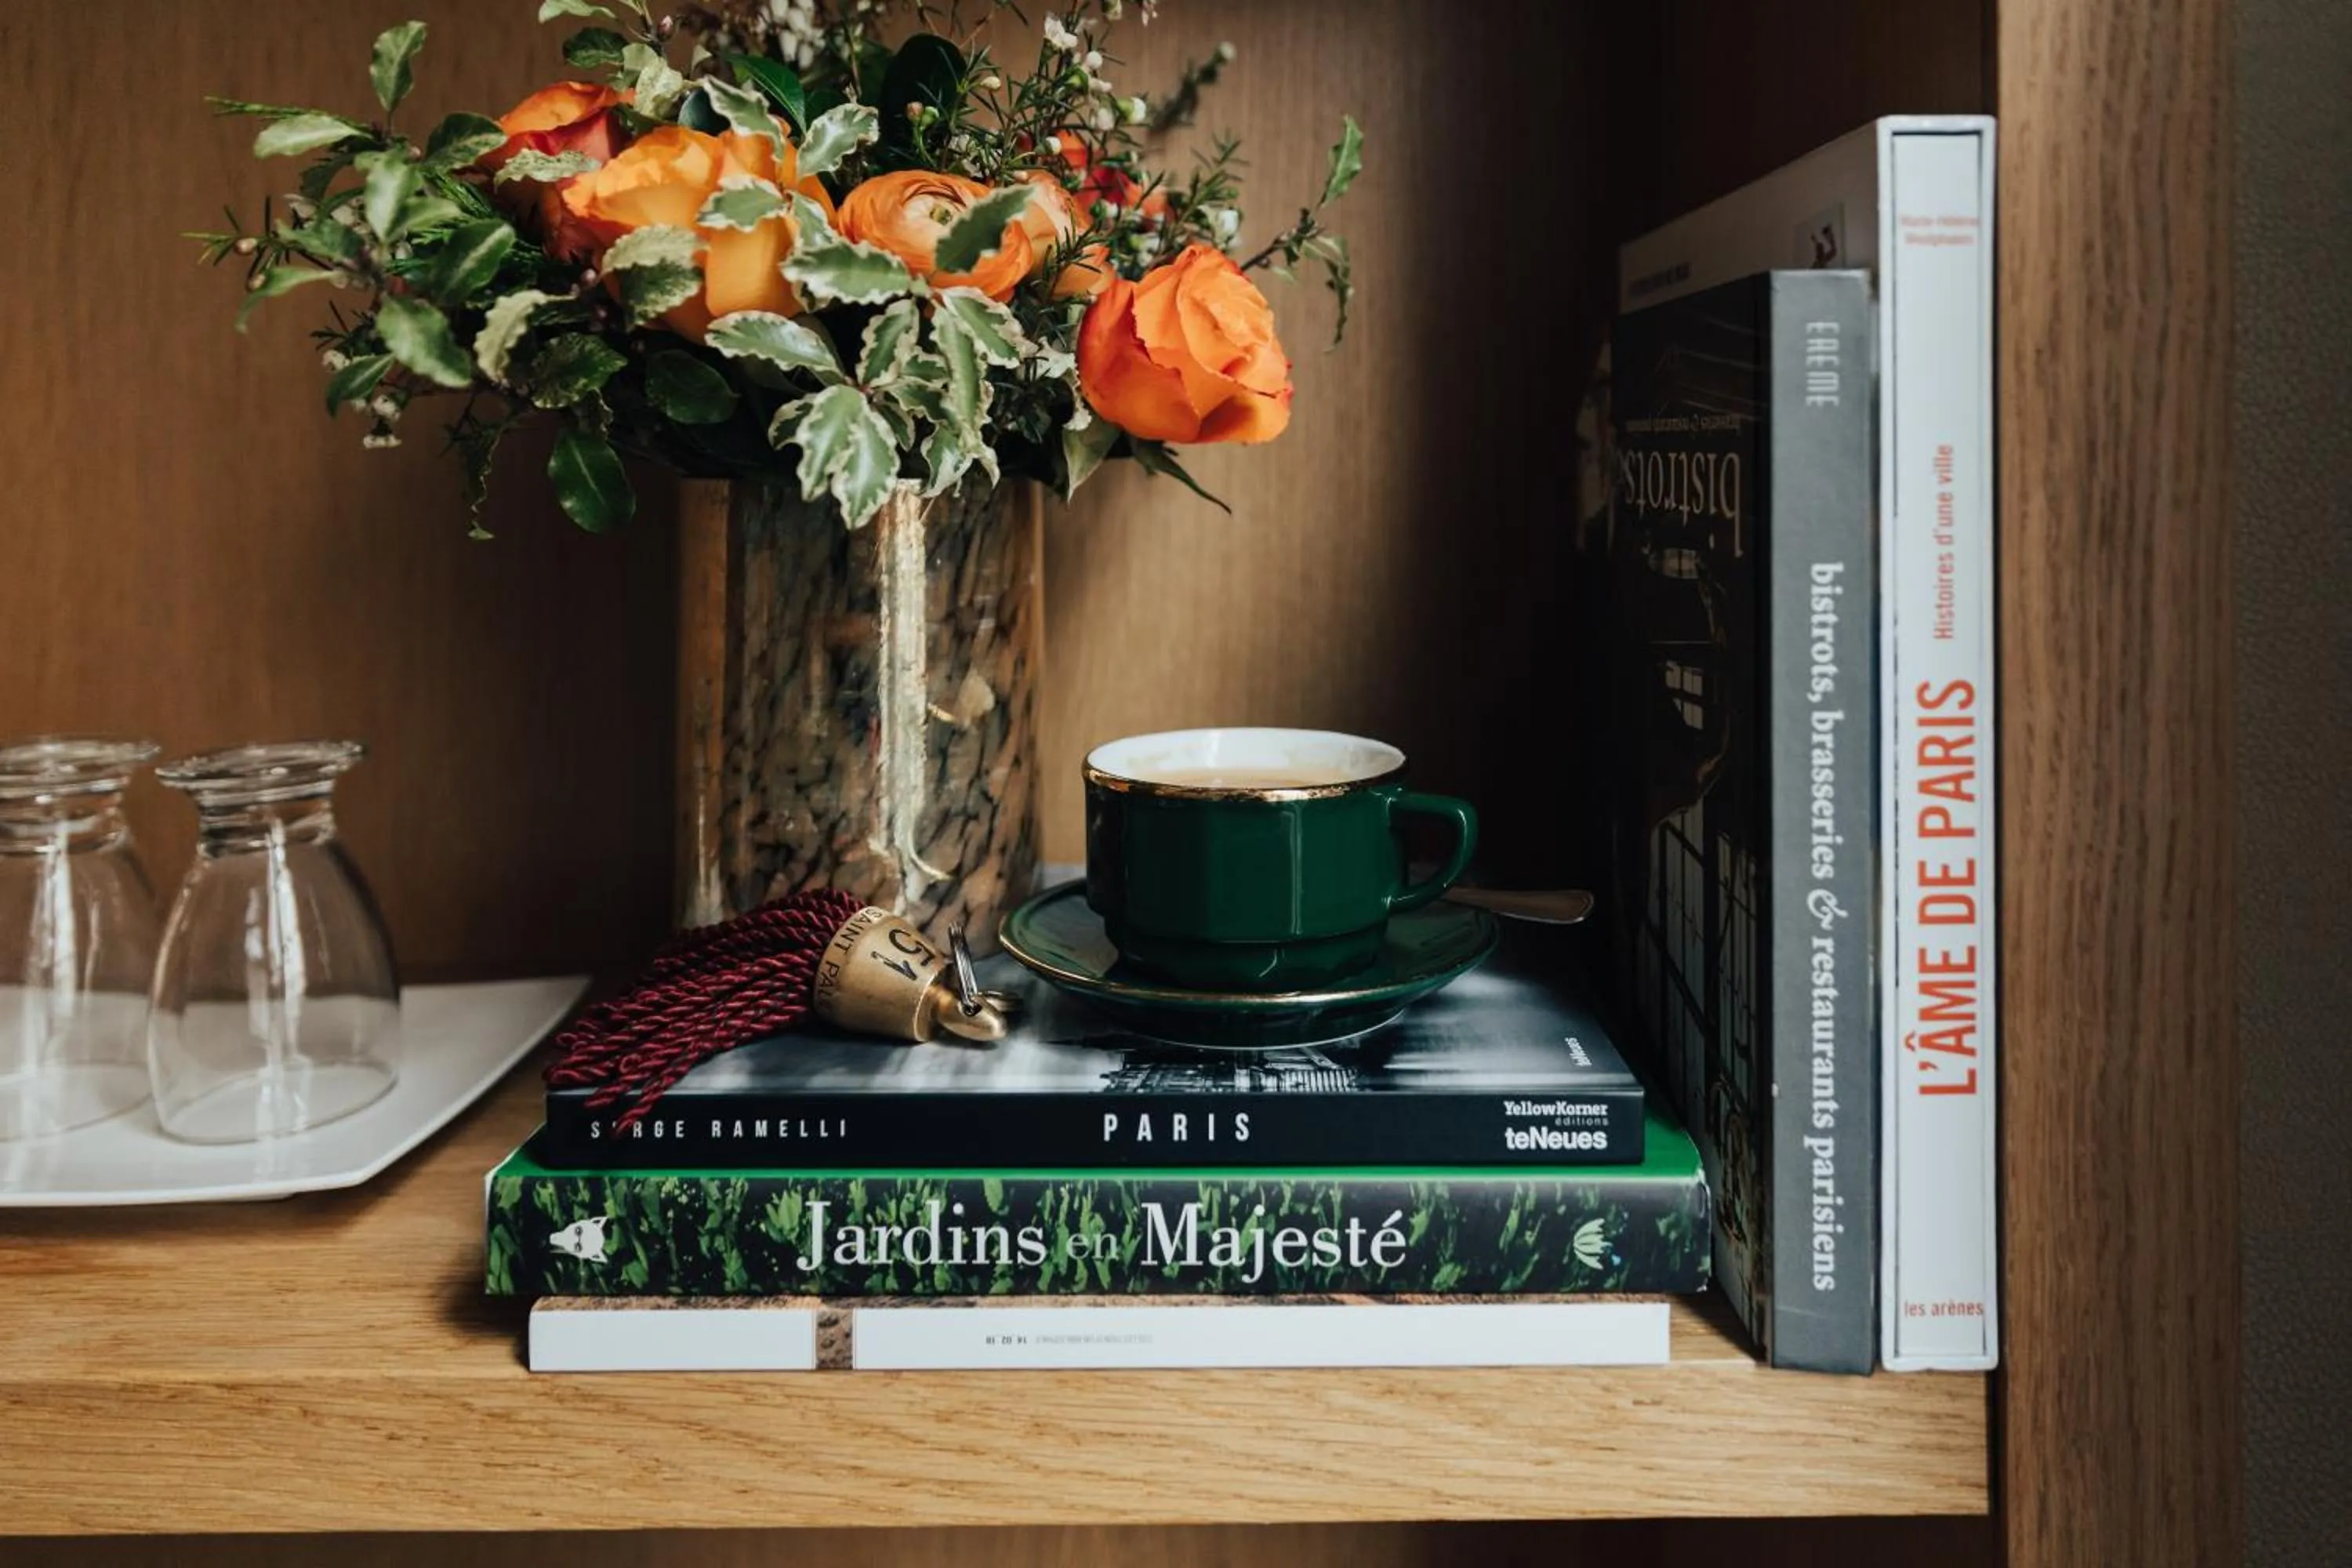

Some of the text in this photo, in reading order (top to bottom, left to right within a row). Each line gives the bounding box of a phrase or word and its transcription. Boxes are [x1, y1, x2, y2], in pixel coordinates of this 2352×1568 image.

[1932, 445, 1955, 640] Histoires d'une ville
[1916, 679, 1976, 838] PARIS
[1918, 859, 1976, 924] DE
[833, 908, 883, 954] SAINT
[1803, 562, 1849, 1291] bistrots, brasseries & restaurants parisiens
[591, 1119, 846, 1138] SRGE RAMELLI
[1103, 1113, 1250, 1142] PARIS
[1504, 1101, 1609, 1116] YellowKorner
[1504, 1126, 1608, 1150] teNeues
[797, 1200, 1408, 1284] Jardins en Majesté
[1904, 1298, 1984, 1317] les arènes
